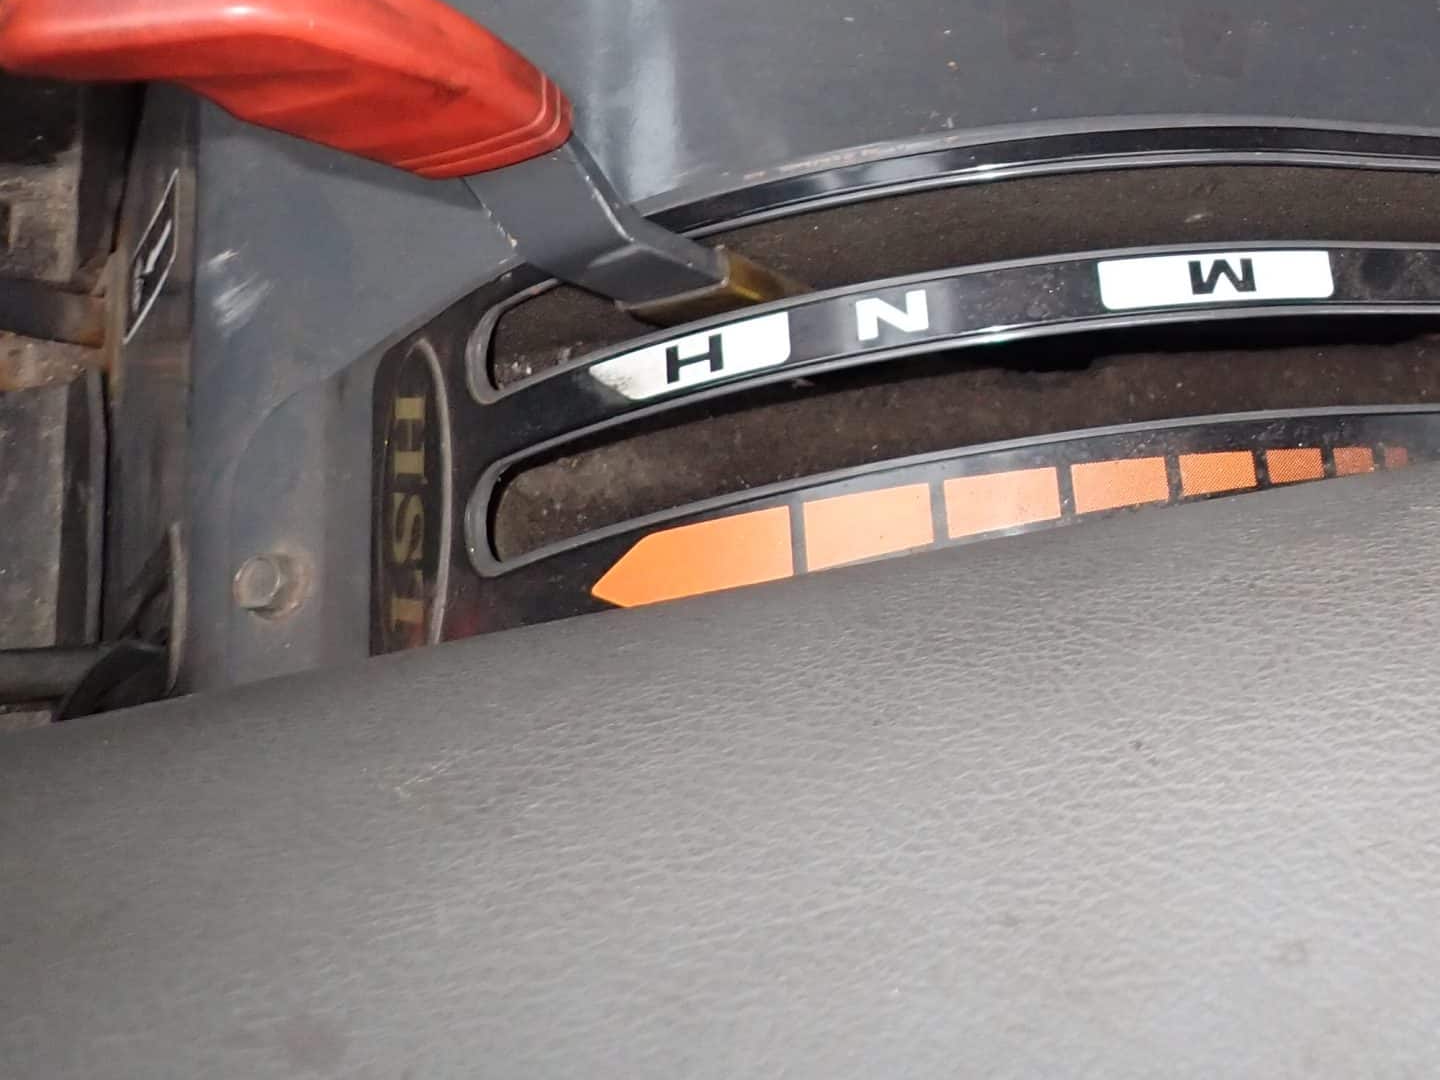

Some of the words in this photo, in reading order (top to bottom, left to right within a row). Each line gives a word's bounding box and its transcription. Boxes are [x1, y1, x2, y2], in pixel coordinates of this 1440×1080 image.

[1188, 258, 1256, 295] M
[855, 289, 929, 341] N
[666, 333, 723, 384] H
